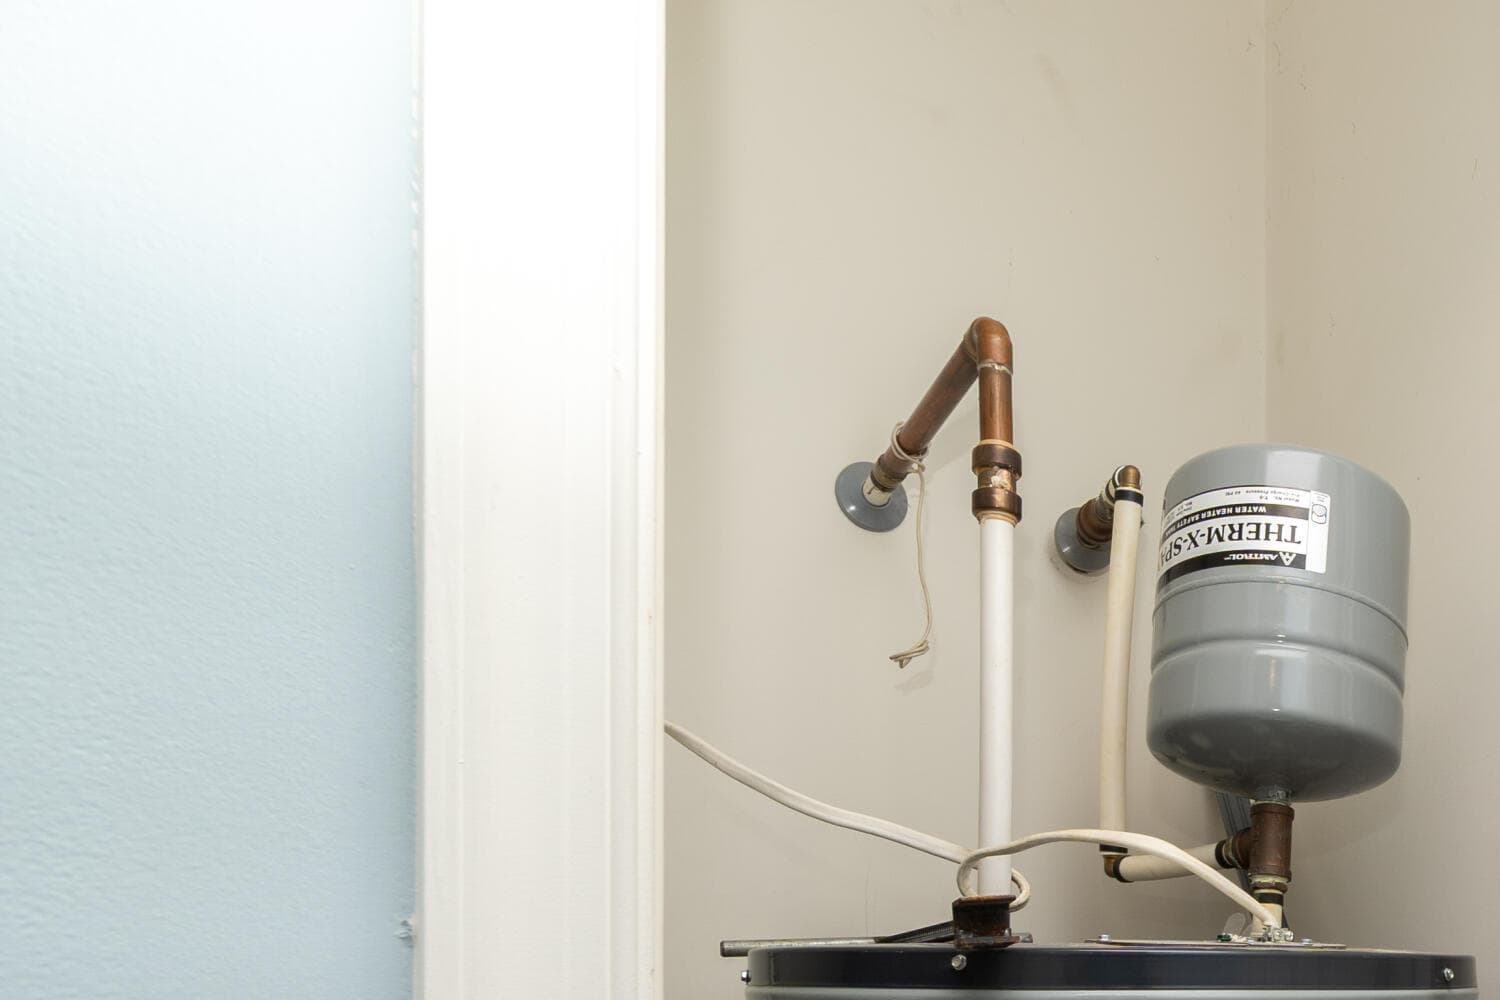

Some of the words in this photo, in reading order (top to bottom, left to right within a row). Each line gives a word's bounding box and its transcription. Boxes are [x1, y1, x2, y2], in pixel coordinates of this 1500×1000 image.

[1200, 508, 1233, 519] HEATER
[1235, 505, 1267, 514] WATER
[1160, 522, 1301, 567] THERM-X-SPA
[1229, 553, 1278, 561] AMTROL
